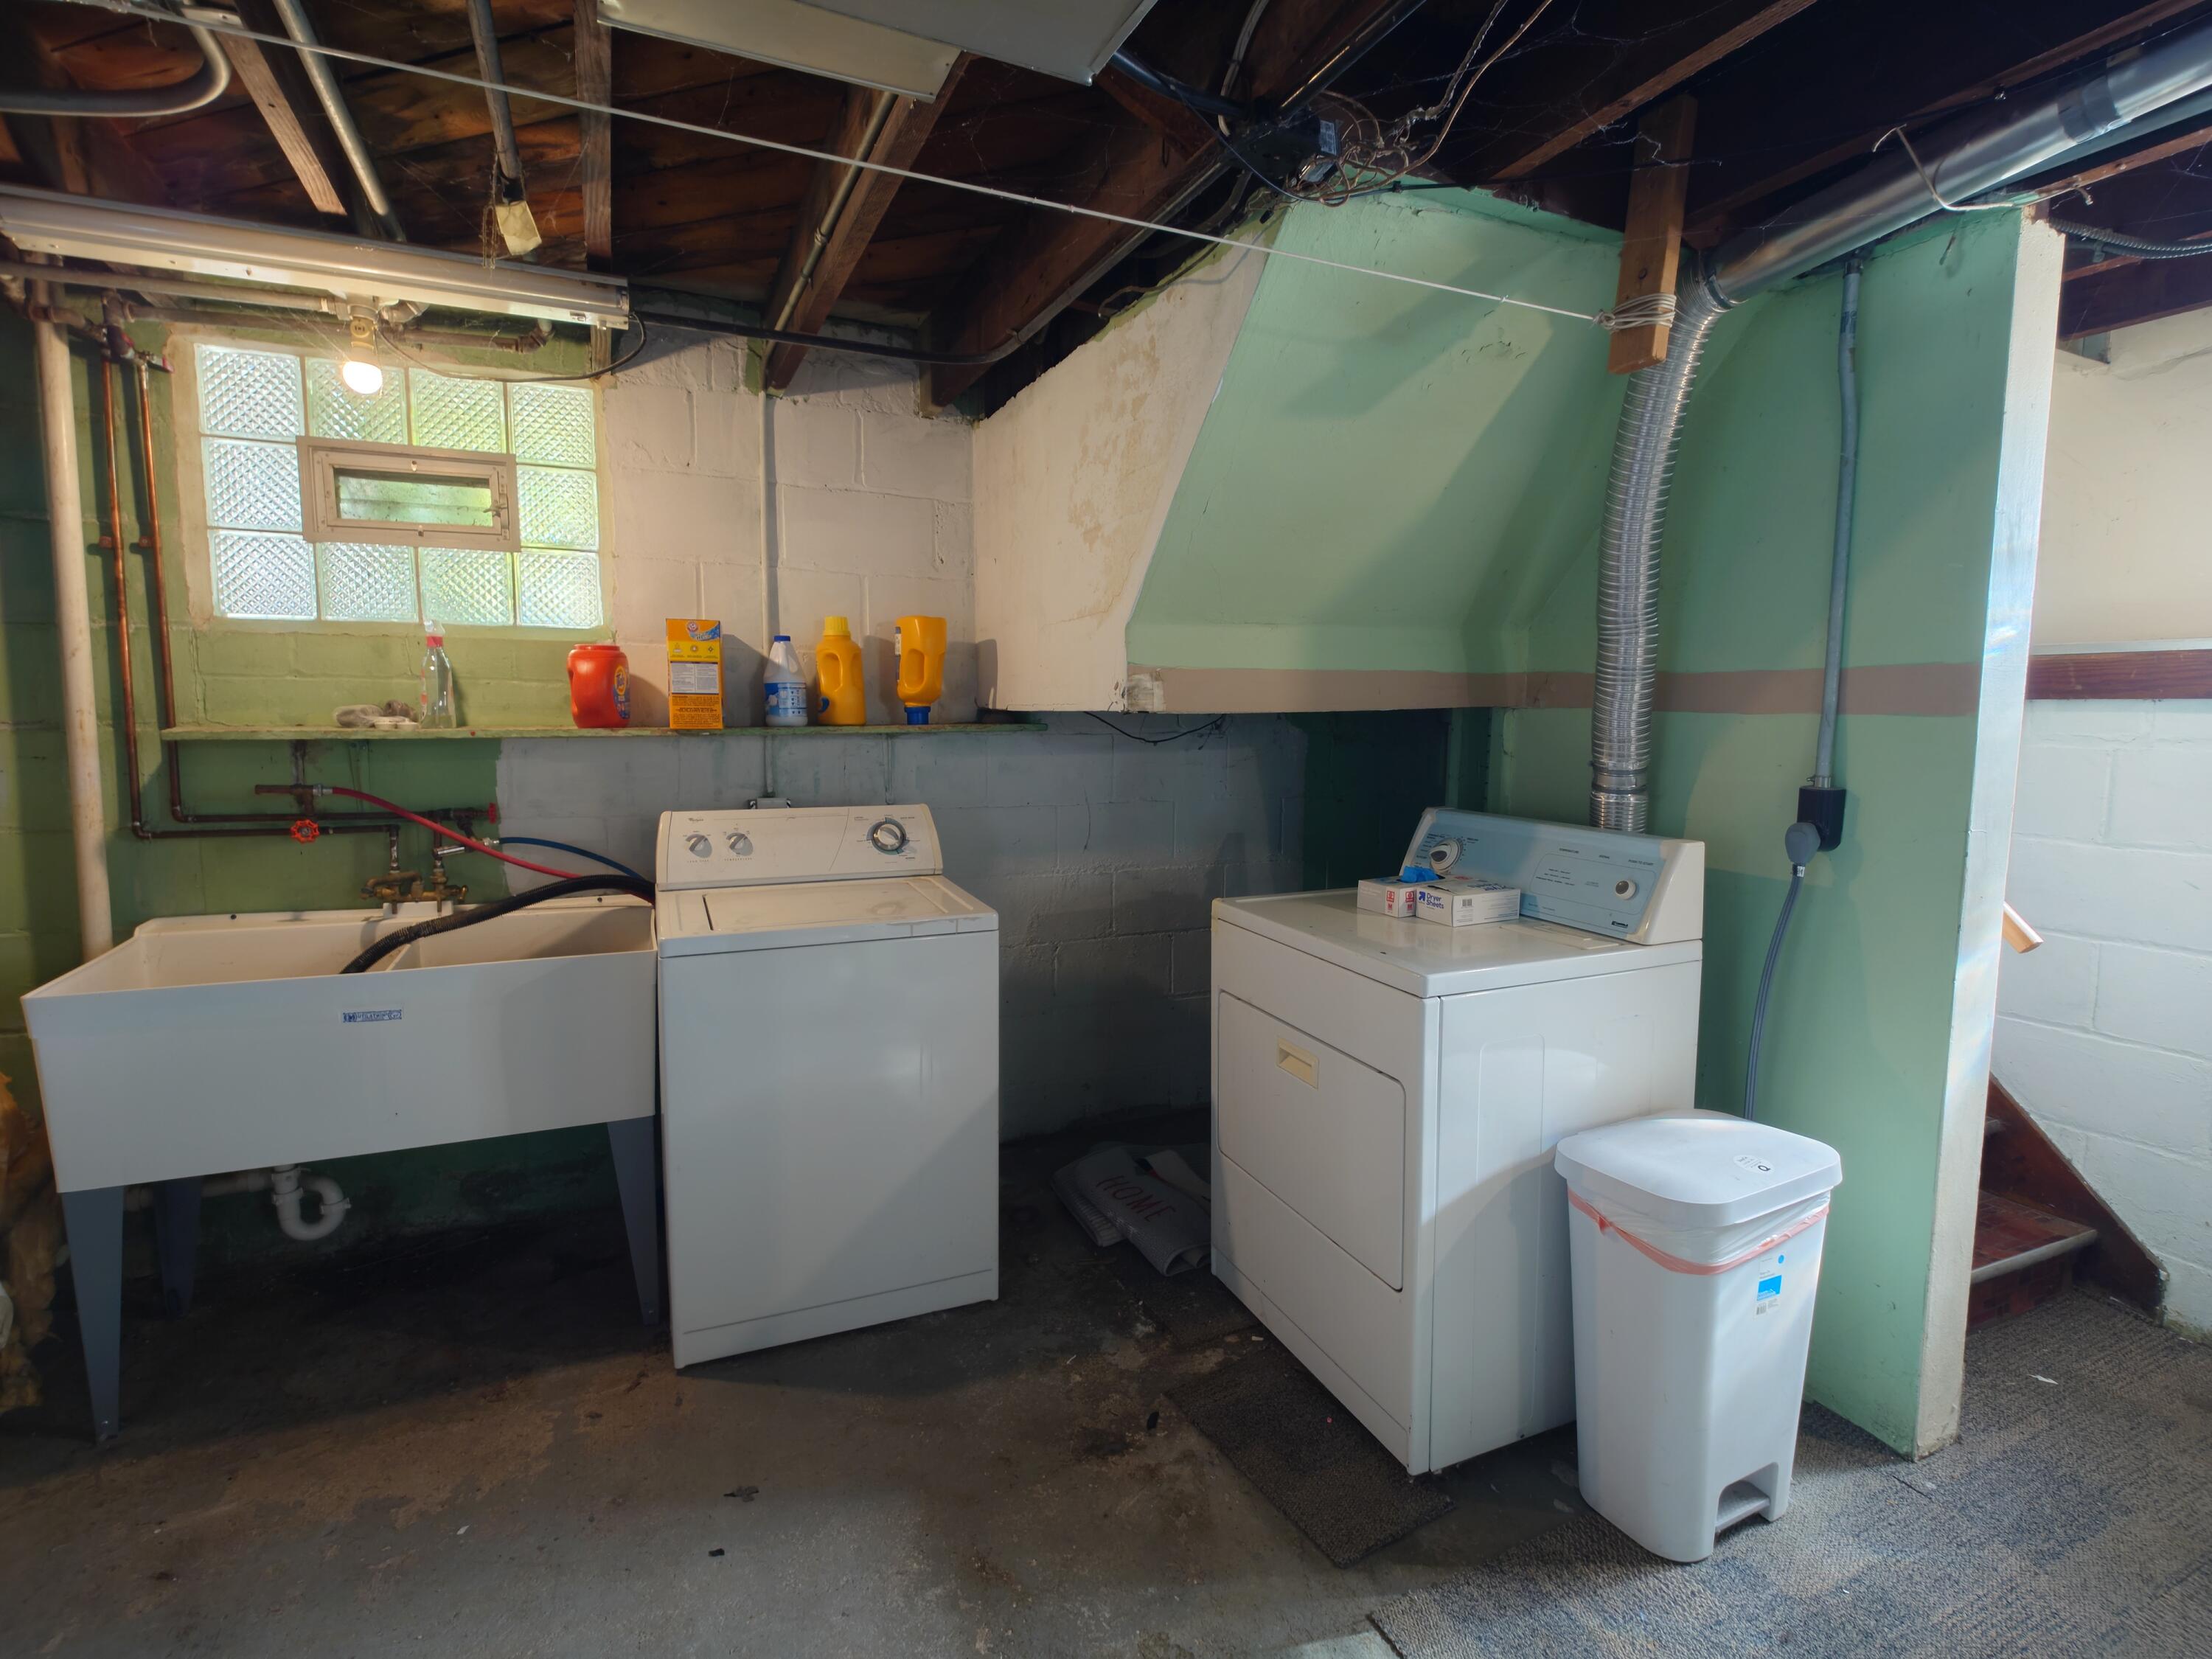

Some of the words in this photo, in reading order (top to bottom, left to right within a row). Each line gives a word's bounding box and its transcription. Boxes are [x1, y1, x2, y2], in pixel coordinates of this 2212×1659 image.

[1427, 893, 1441, 902] Dryer
[1426, 900, 1444, 908] Sheets
[1095, 1175, 1176, 1222] HOME
